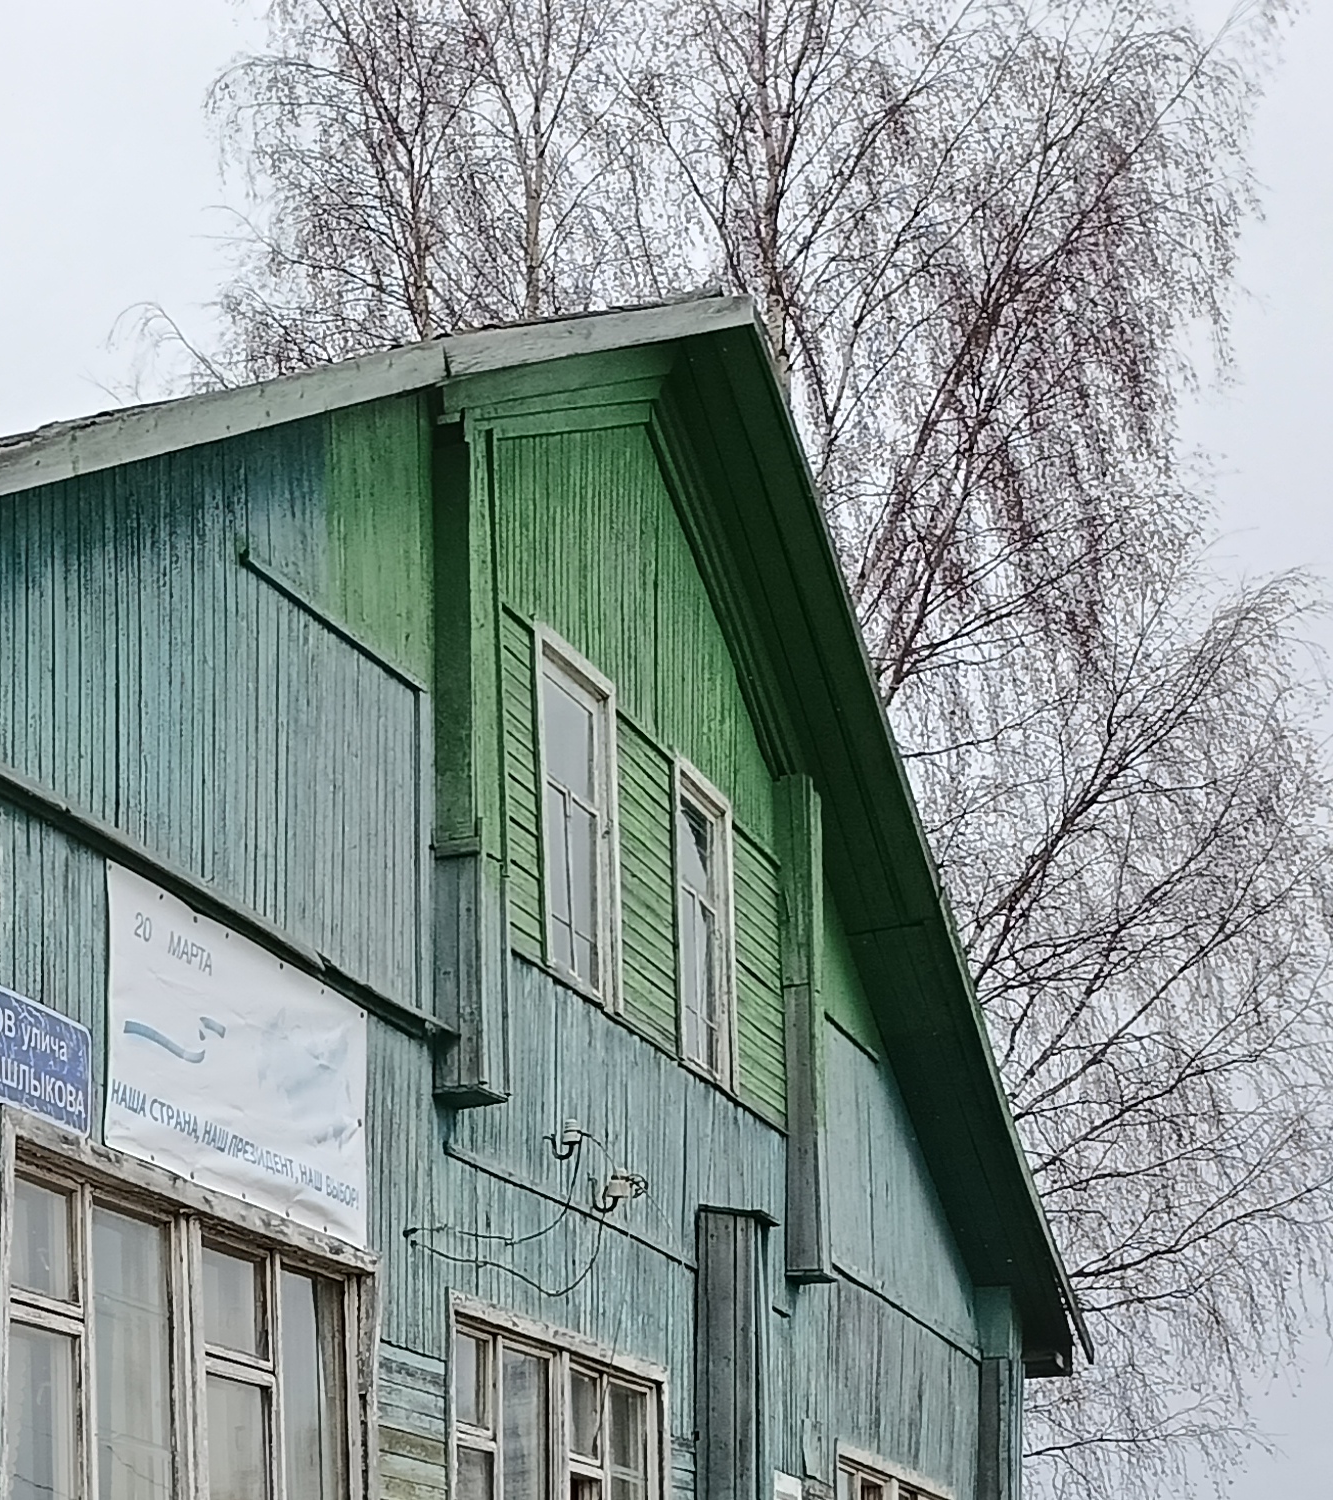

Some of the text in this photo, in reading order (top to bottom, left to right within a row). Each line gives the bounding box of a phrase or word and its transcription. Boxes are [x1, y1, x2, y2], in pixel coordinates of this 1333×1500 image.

[133, 911, 213, 977] 20 МАРТА
[21, 1021, 68, 1062] улича
[111, 1078, 147, 1117] НАША
[149, 1098, 200, 1144] СТРАНА,
[201, 1120, 229, 1153] НАШ
[299, 1163, 323, 1192] НАШ
[325, 1174, 360, 1211] ВЫБОР!
